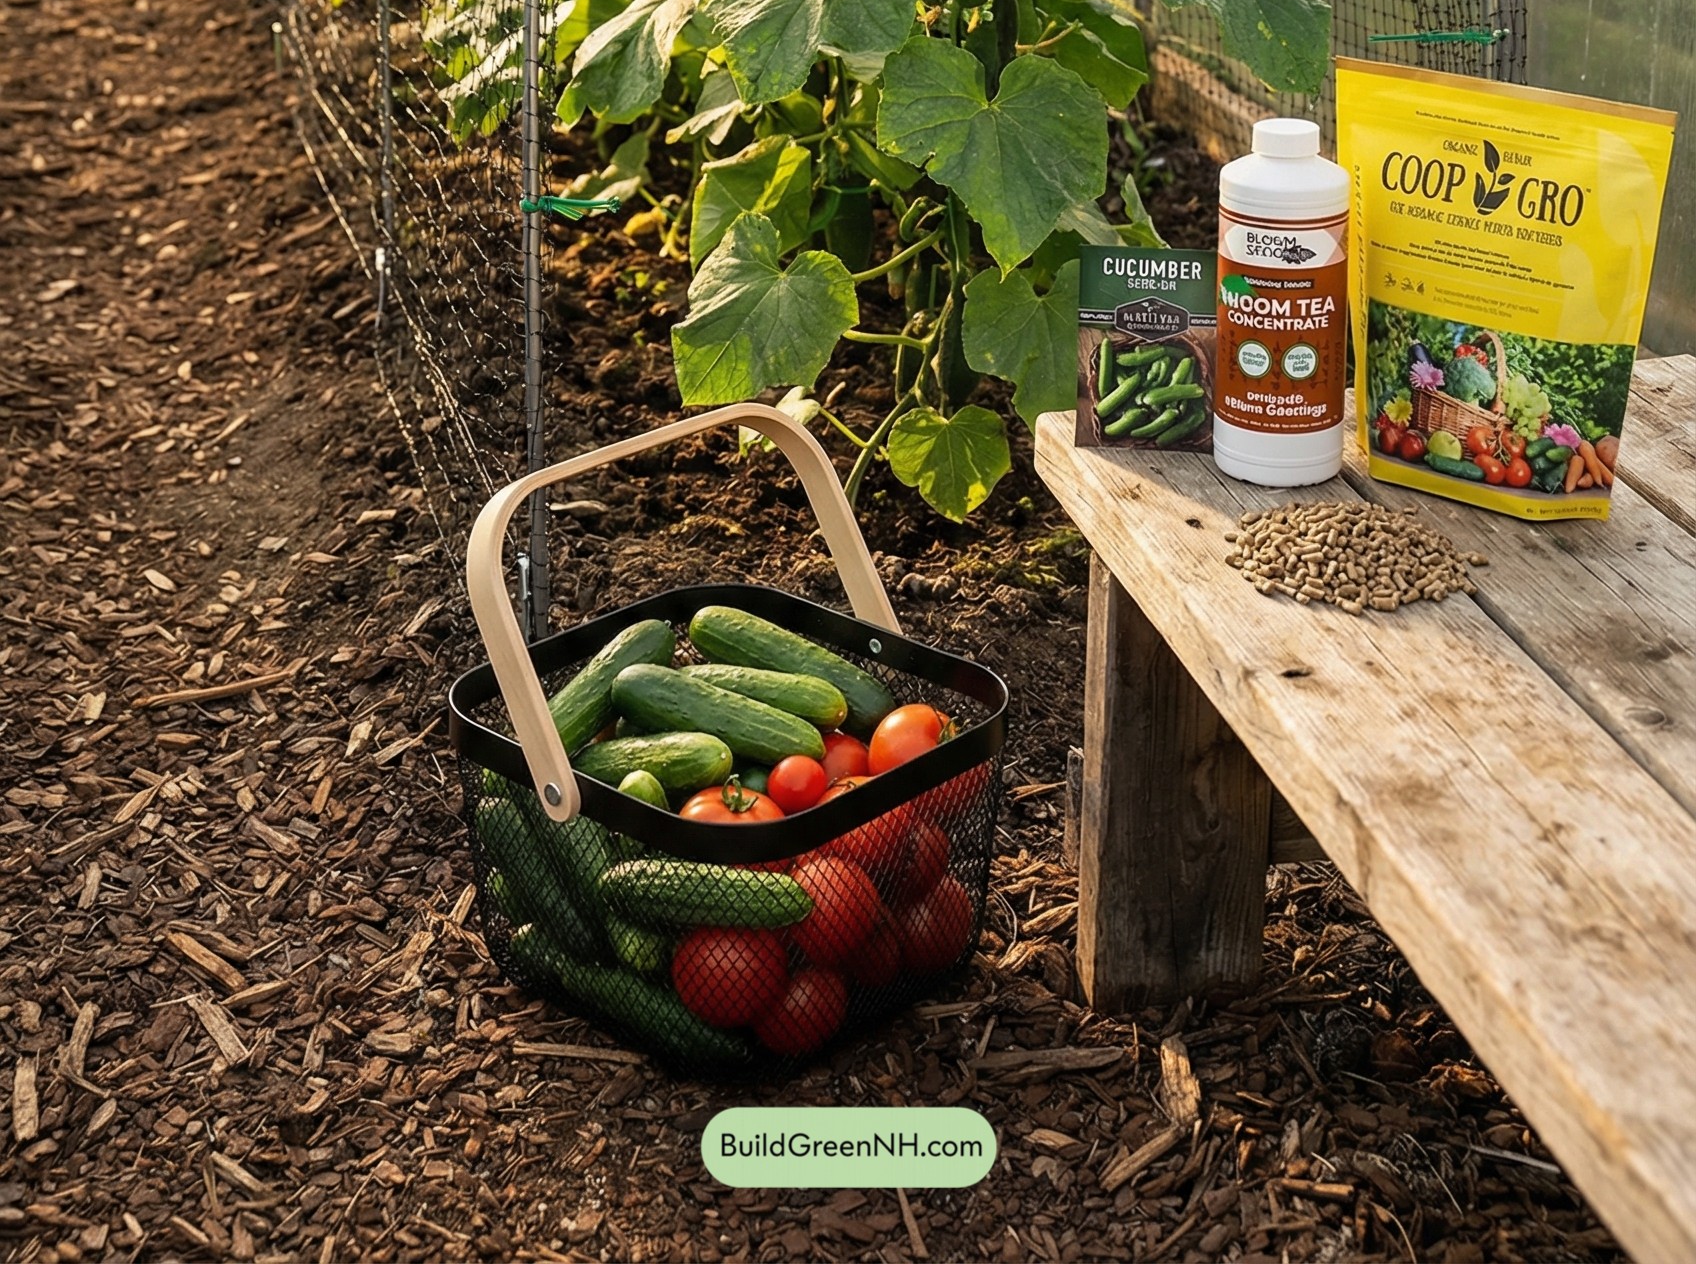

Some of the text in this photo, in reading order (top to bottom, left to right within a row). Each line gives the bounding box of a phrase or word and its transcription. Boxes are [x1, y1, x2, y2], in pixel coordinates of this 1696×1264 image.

[1381, 151, 1466, 204] COOP
[1517, 177, 1585, 227] GRO
[1103, 257, 1202, 280] CUCUMBER
[1296, 296, 1336, 317] TEA
[1227, 309, 1329, 331] CONCENTRATE
